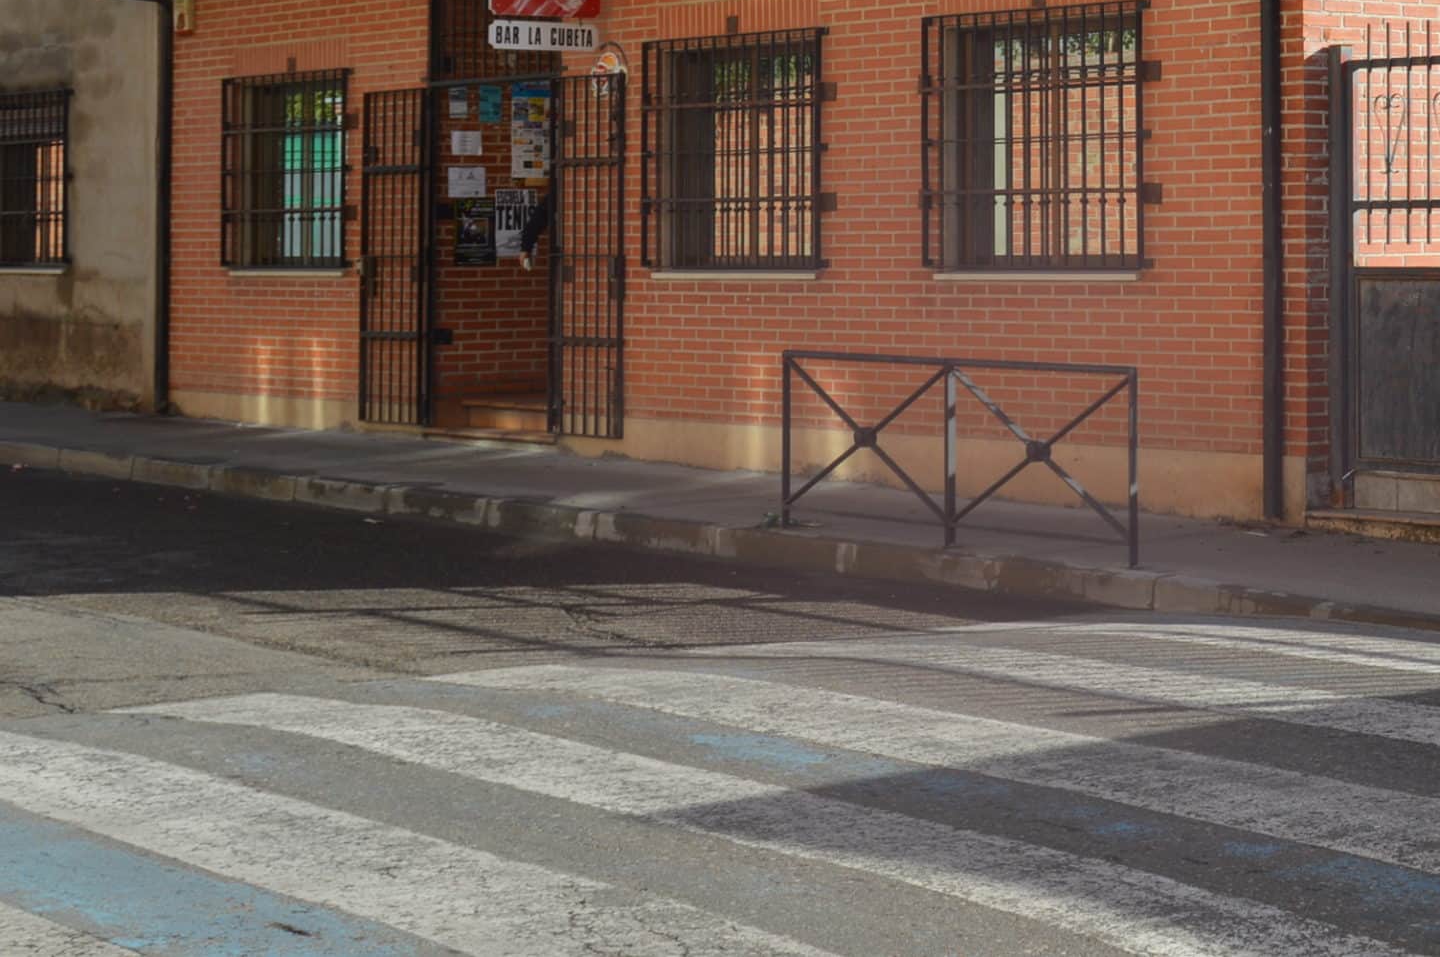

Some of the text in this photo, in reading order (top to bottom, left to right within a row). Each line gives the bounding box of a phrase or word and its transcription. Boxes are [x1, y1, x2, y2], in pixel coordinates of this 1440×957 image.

[496, 25, 593, 47] BAR LA CUBETA
